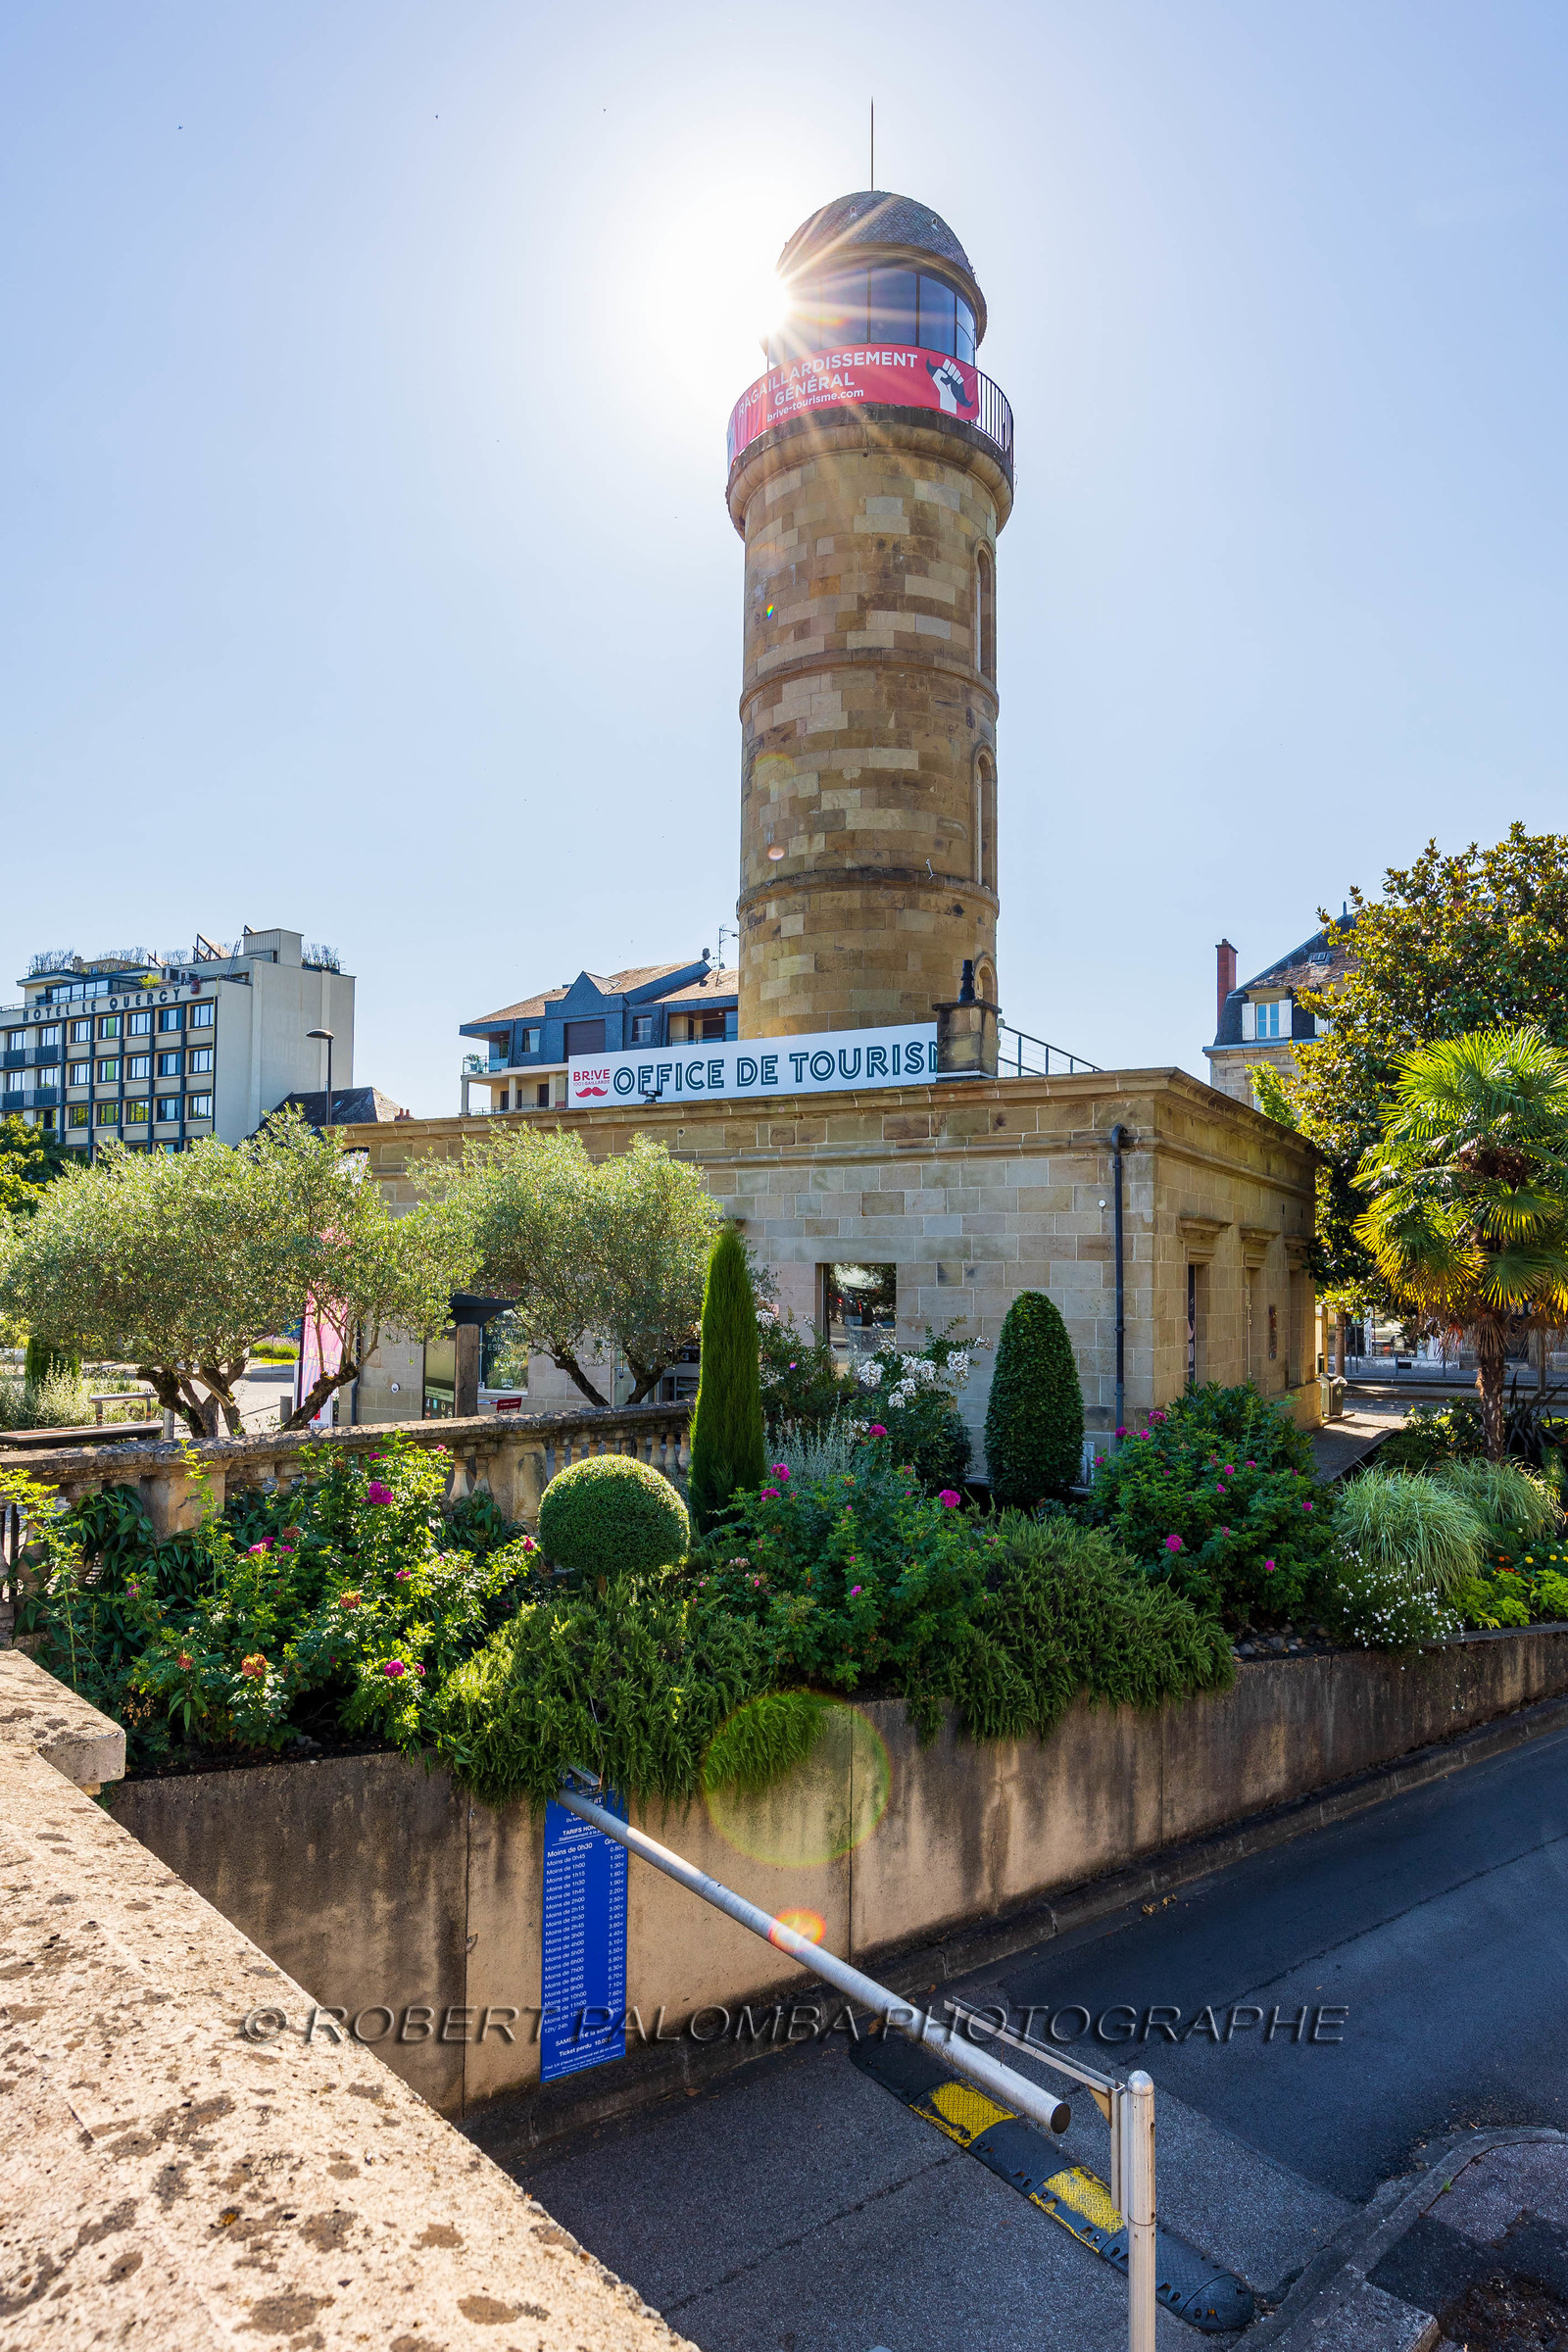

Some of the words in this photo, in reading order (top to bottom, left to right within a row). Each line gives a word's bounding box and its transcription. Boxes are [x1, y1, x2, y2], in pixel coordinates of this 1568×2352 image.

[738, 352, 917, 416] RAGAILLARDISSEMENT
[774, 372, 855, 406] GÉNÉRAL
[766, 388, 864, 422] brive-tourisme.com
[82, 1001, 97, 1013] LE
[109, 988, 180, 1010] QUERCY
[613, 1059, 724, 1096] OFFICE
[737, 1054, 779, 1087] DE
[563, 1827, 582, 1836] TARIFS
[547, 1848, 566, 1858] Moins
[577, 1842, 592, 1851] 0h30
[545, 1929, 562, 1937] Moins
[545, 1937, 562, 1946] Moins
[545, 1946, 562, 1954] Moins
[545, 1955, 562, 1963] Moins
[545, 1964, 561, 1972] Moins
[544, 1972, 561, 1981] Moins
[544, 1981, 561, 1990] Moins
[544, 1990, 561, 1998] Moins
[544, 1999, 561, 2007] Moins
[544, 2016, 561, 2025] Moins
[555, 2035, 578, 2046] SAMEDI
[559, 2048, 575, 2057] Ticket
[576, 2043, 592, 2053] perdu
